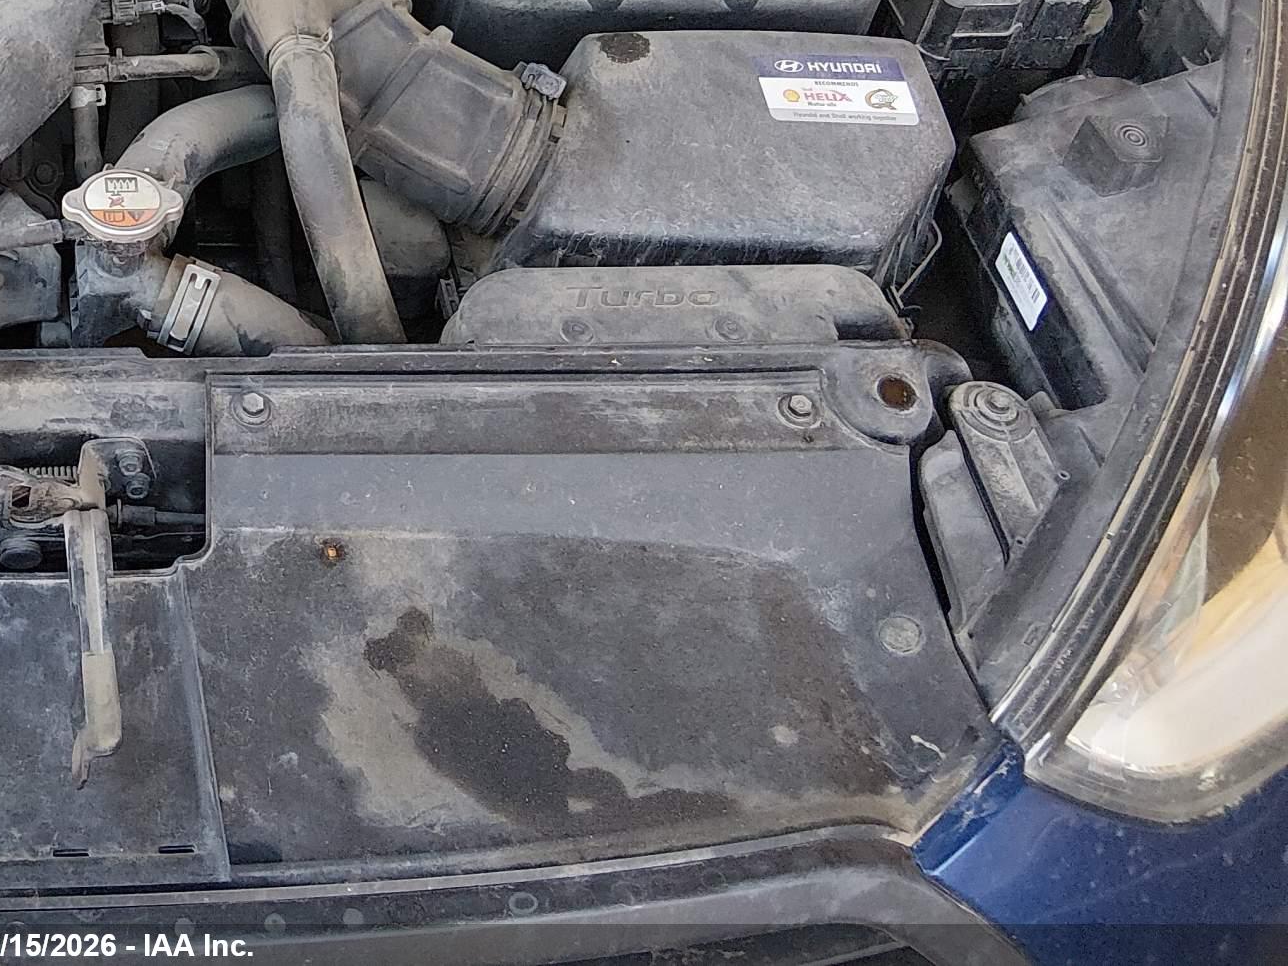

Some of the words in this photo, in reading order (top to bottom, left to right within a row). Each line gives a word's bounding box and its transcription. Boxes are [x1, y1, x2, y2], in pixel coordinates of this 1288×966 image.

[807, 62, 883, 74] HYUNDAI
[803, 90, 853, 102] HELIX
[566, 285, 721, 309] Turbo
